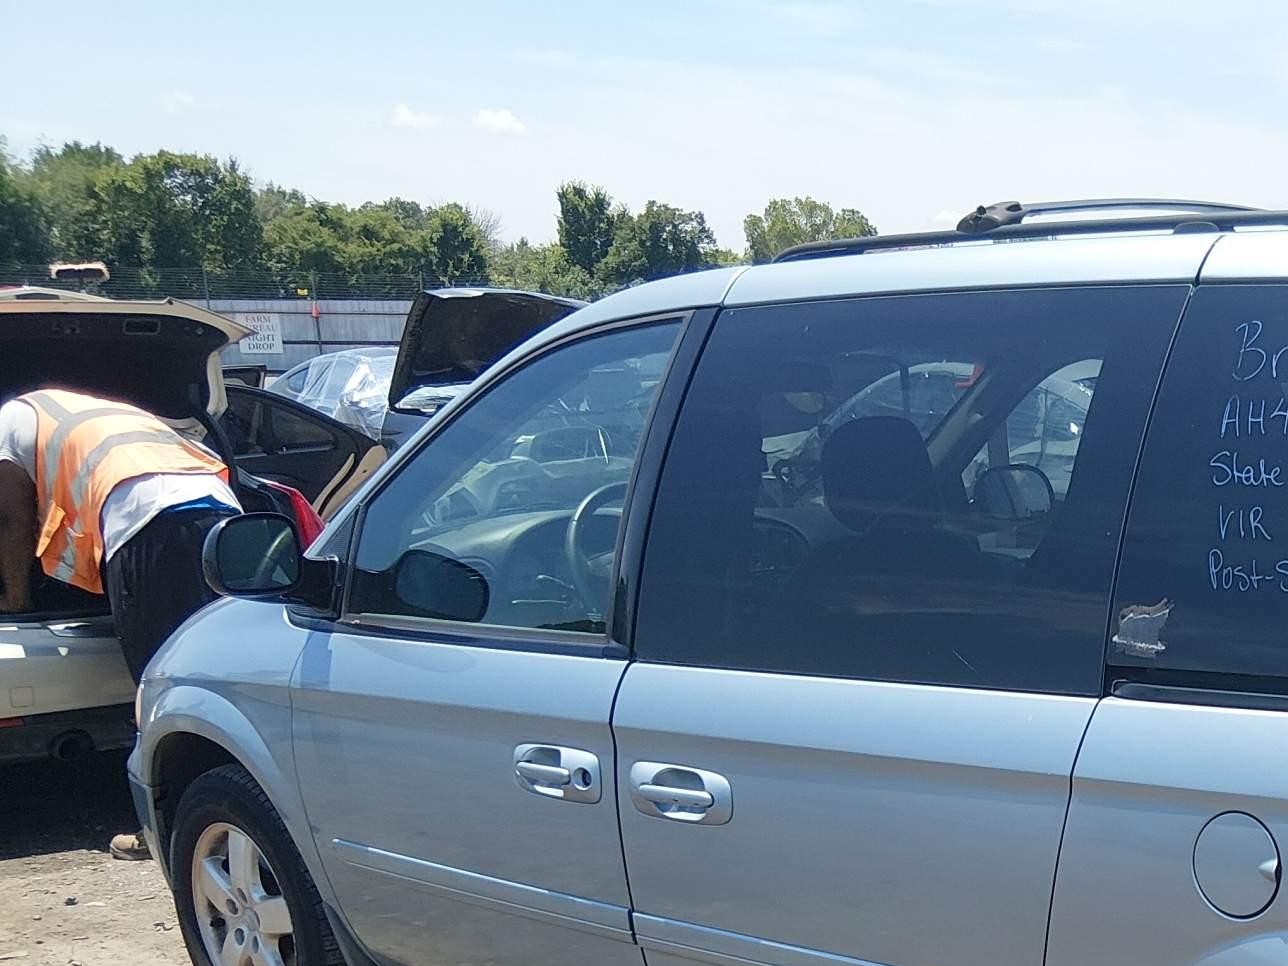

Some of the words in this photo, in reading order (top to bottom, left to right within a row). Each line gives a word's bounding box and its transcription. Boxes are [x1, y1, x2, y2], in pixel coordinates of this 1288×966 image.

[245, 315, 271, 323] FARM
[247, 334, 275, 342] NIGHT
[248, 342, 275, 351] DROP
[1209, 451, 1285, 487] State
